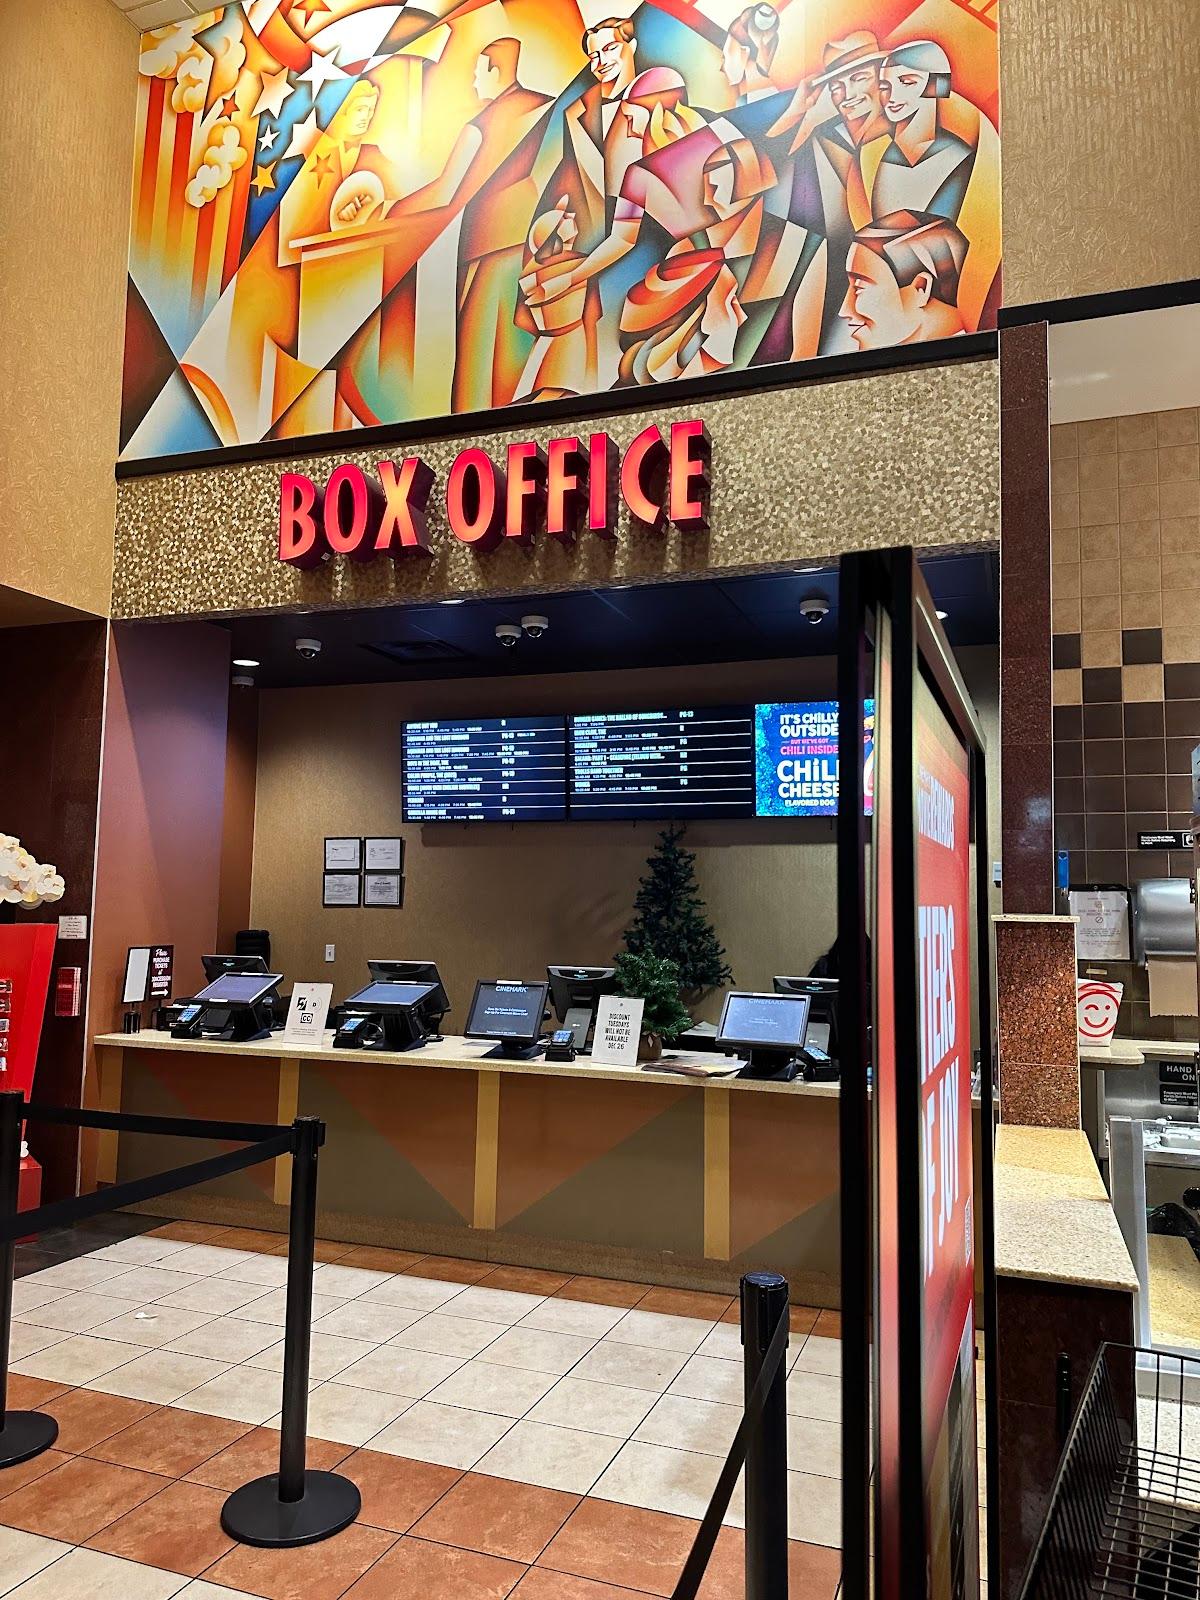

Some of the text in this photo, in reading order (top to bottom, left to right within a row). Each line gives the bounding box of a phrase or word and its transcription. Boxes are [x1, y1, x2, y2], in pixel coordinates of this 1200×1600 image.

[279, 419, 704, 562] BOX OFFICE
[780, 714, 801, 725] IT'S
[780, 723, 839, 738] OUTSIDE
[780, 745, 839, 755] CHILI INSIDE
[778, 782, 840, 799] CHEESE
[784, 799, 819, 807] FLAVORED
[918, 904, 956, 1085] TIERS
[608, 1020, 630, 1028] TUESDAYS
[1166, 1065, 1192, 1073] HAND
[1181, 1073, 1195, 1081] ON
[938, 1056, 960, 1247] JOY
